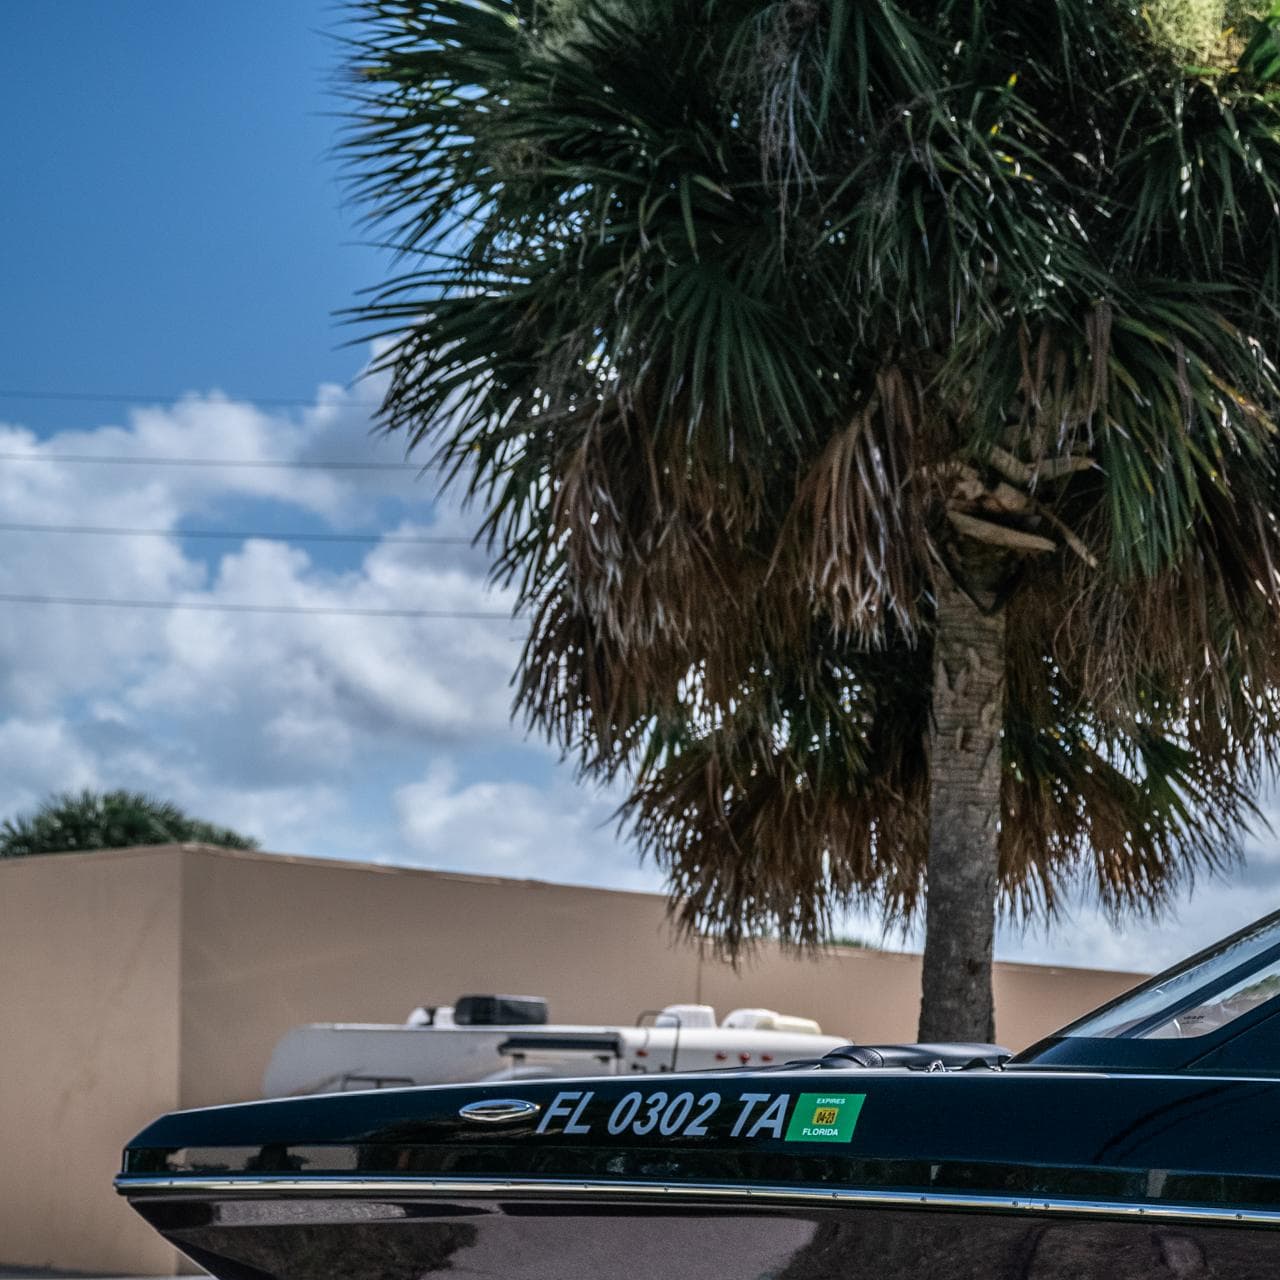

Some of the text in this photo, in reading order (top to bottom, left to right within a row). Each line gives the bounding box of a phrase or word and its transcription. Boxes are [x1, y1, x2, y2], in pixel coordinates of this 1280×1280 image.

[816, 1097, 846, 1105] EXPIRES
[536, 1091, 790, 1139] FL 0302 TA
[802, 1127, 839, 1136] FLORIDA
